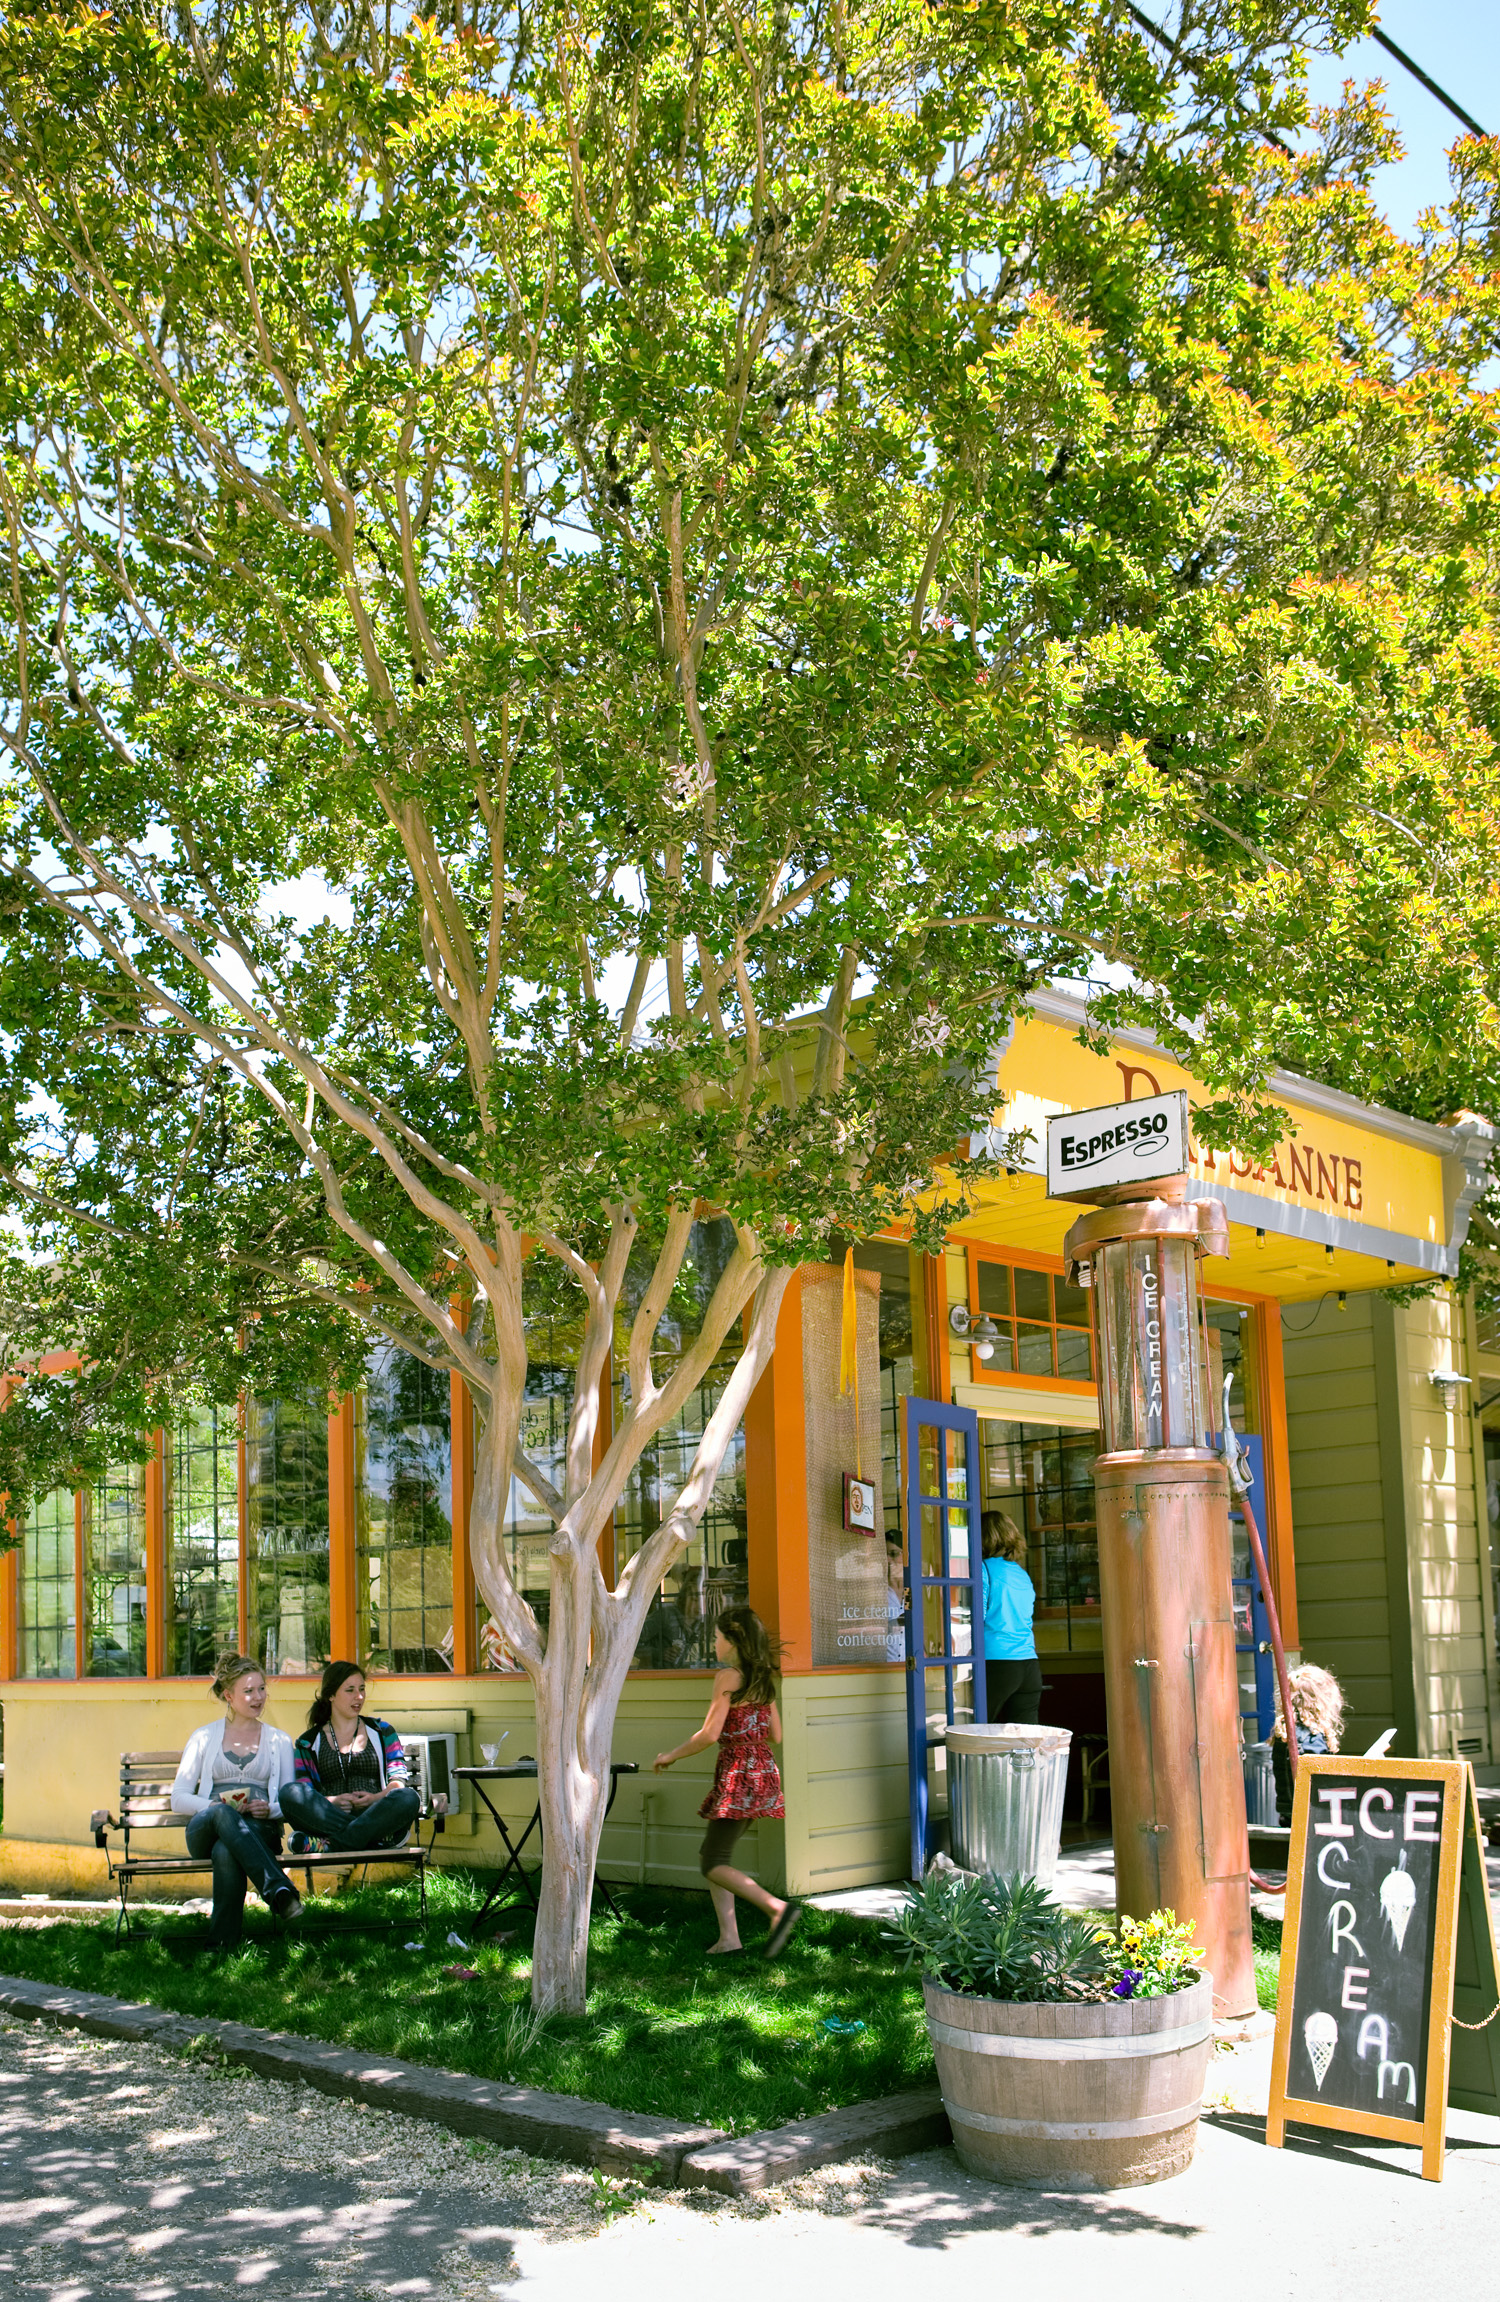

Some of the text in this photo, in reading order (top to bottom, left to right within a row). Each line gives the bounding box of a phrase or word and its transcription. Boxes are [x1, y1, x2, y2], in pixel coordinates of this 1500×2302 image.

[1061, 1113, 1168, 1166] ESPRESSO
[1141, 1254, 1158, 1308] ICE
[842, 1602, 899, 1618] ice cream
[1314, 1787, 1440, 1841] ICE
